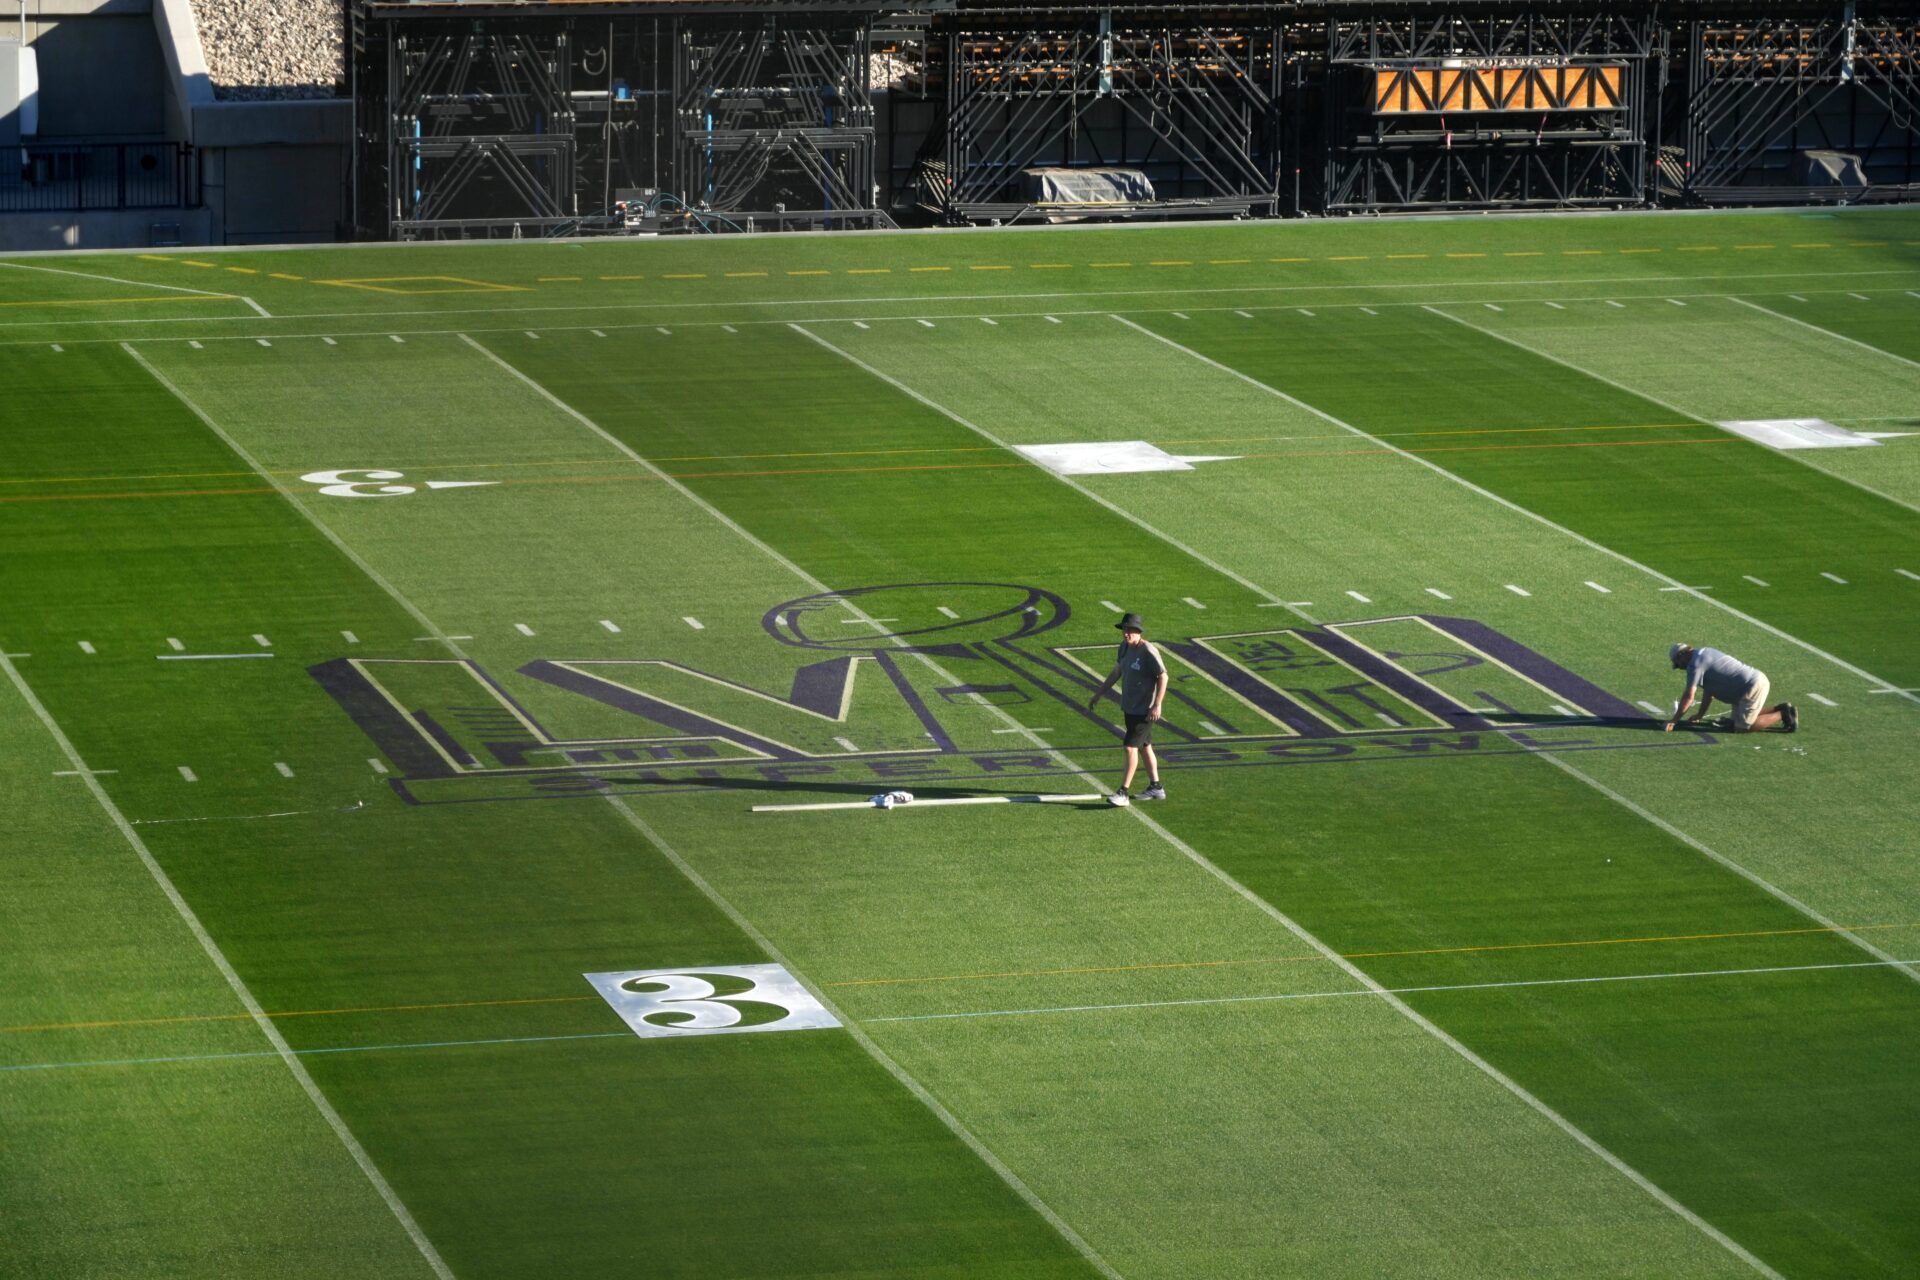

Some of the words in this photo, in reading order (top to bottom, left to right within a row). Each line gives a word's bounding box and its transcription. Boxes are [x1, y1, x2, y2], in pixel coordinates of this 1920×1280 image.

[300, 469, 416, 497] 3
[1157, 732, 1594, 764] BOWL
[621, 973, 790, 1029] 3
